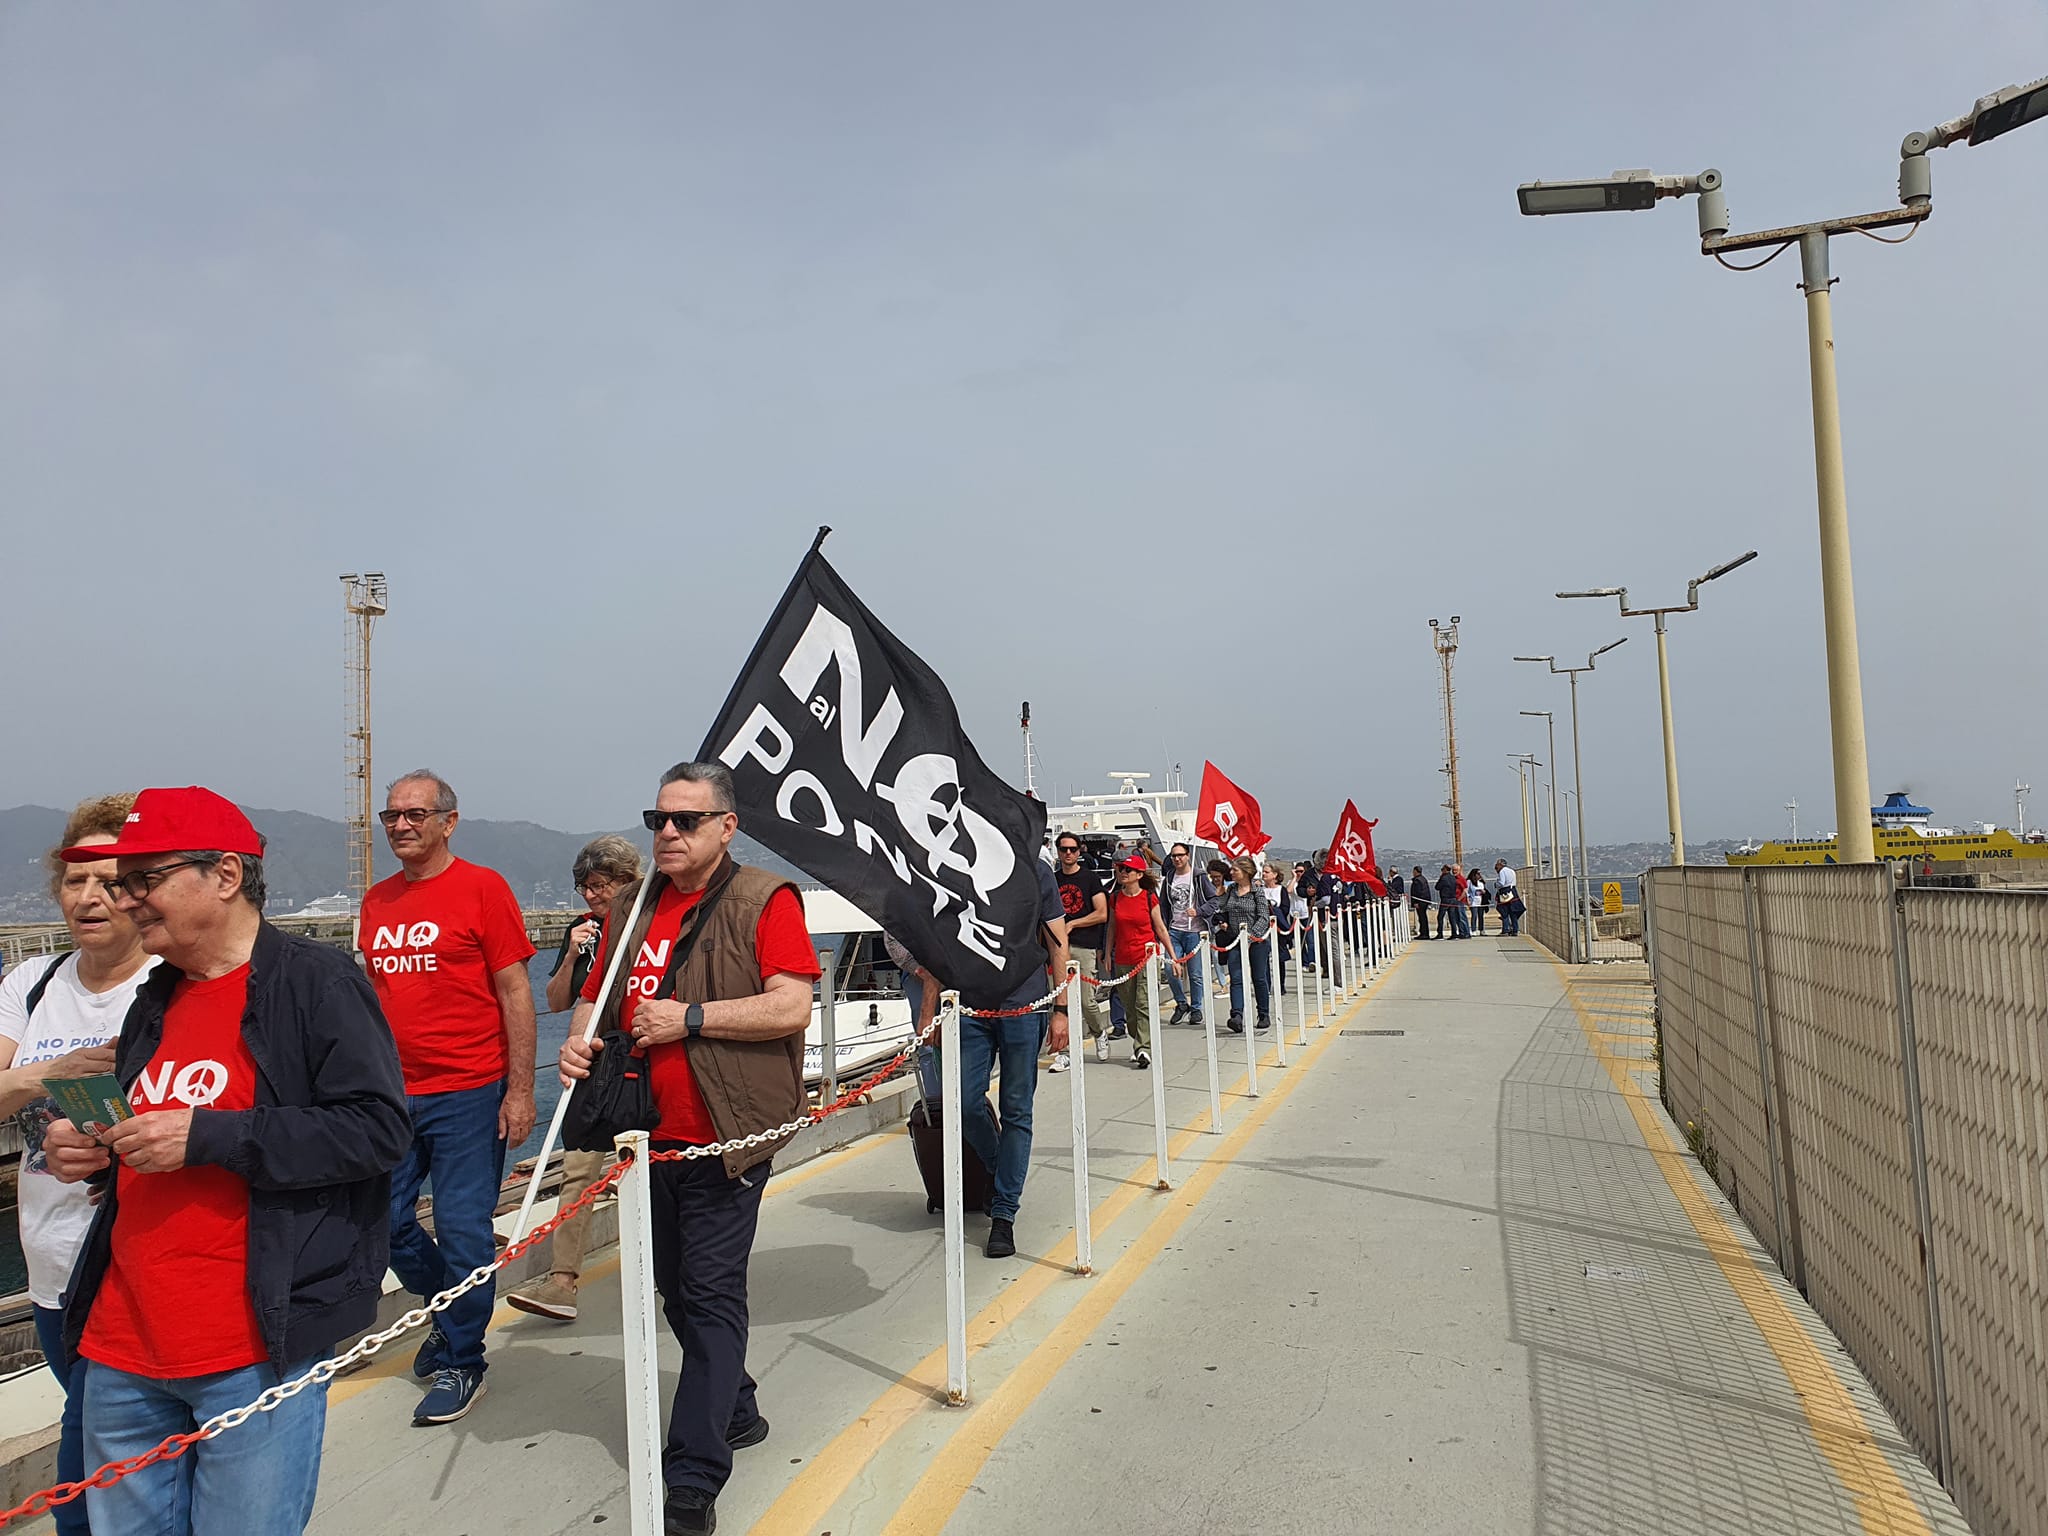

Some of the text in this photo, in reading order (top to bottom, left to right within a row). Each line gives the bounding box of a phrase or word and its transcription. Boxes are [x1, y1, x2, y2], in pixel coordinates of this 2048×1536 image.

[809, 694, 837, 730] al
[779, 603, 1015, 905] NO
[718, 703, 1006, 971] PONTE
[1965, 849, 2013, 859] UN MARE
[372, 921, 439, 952] NO
[372, 953, 438, 975] PONTE
[36, 1039, 64, 1050] NO
[126, 1059, 228, 1107] NO
[132, 1094, 143, 1105] al
